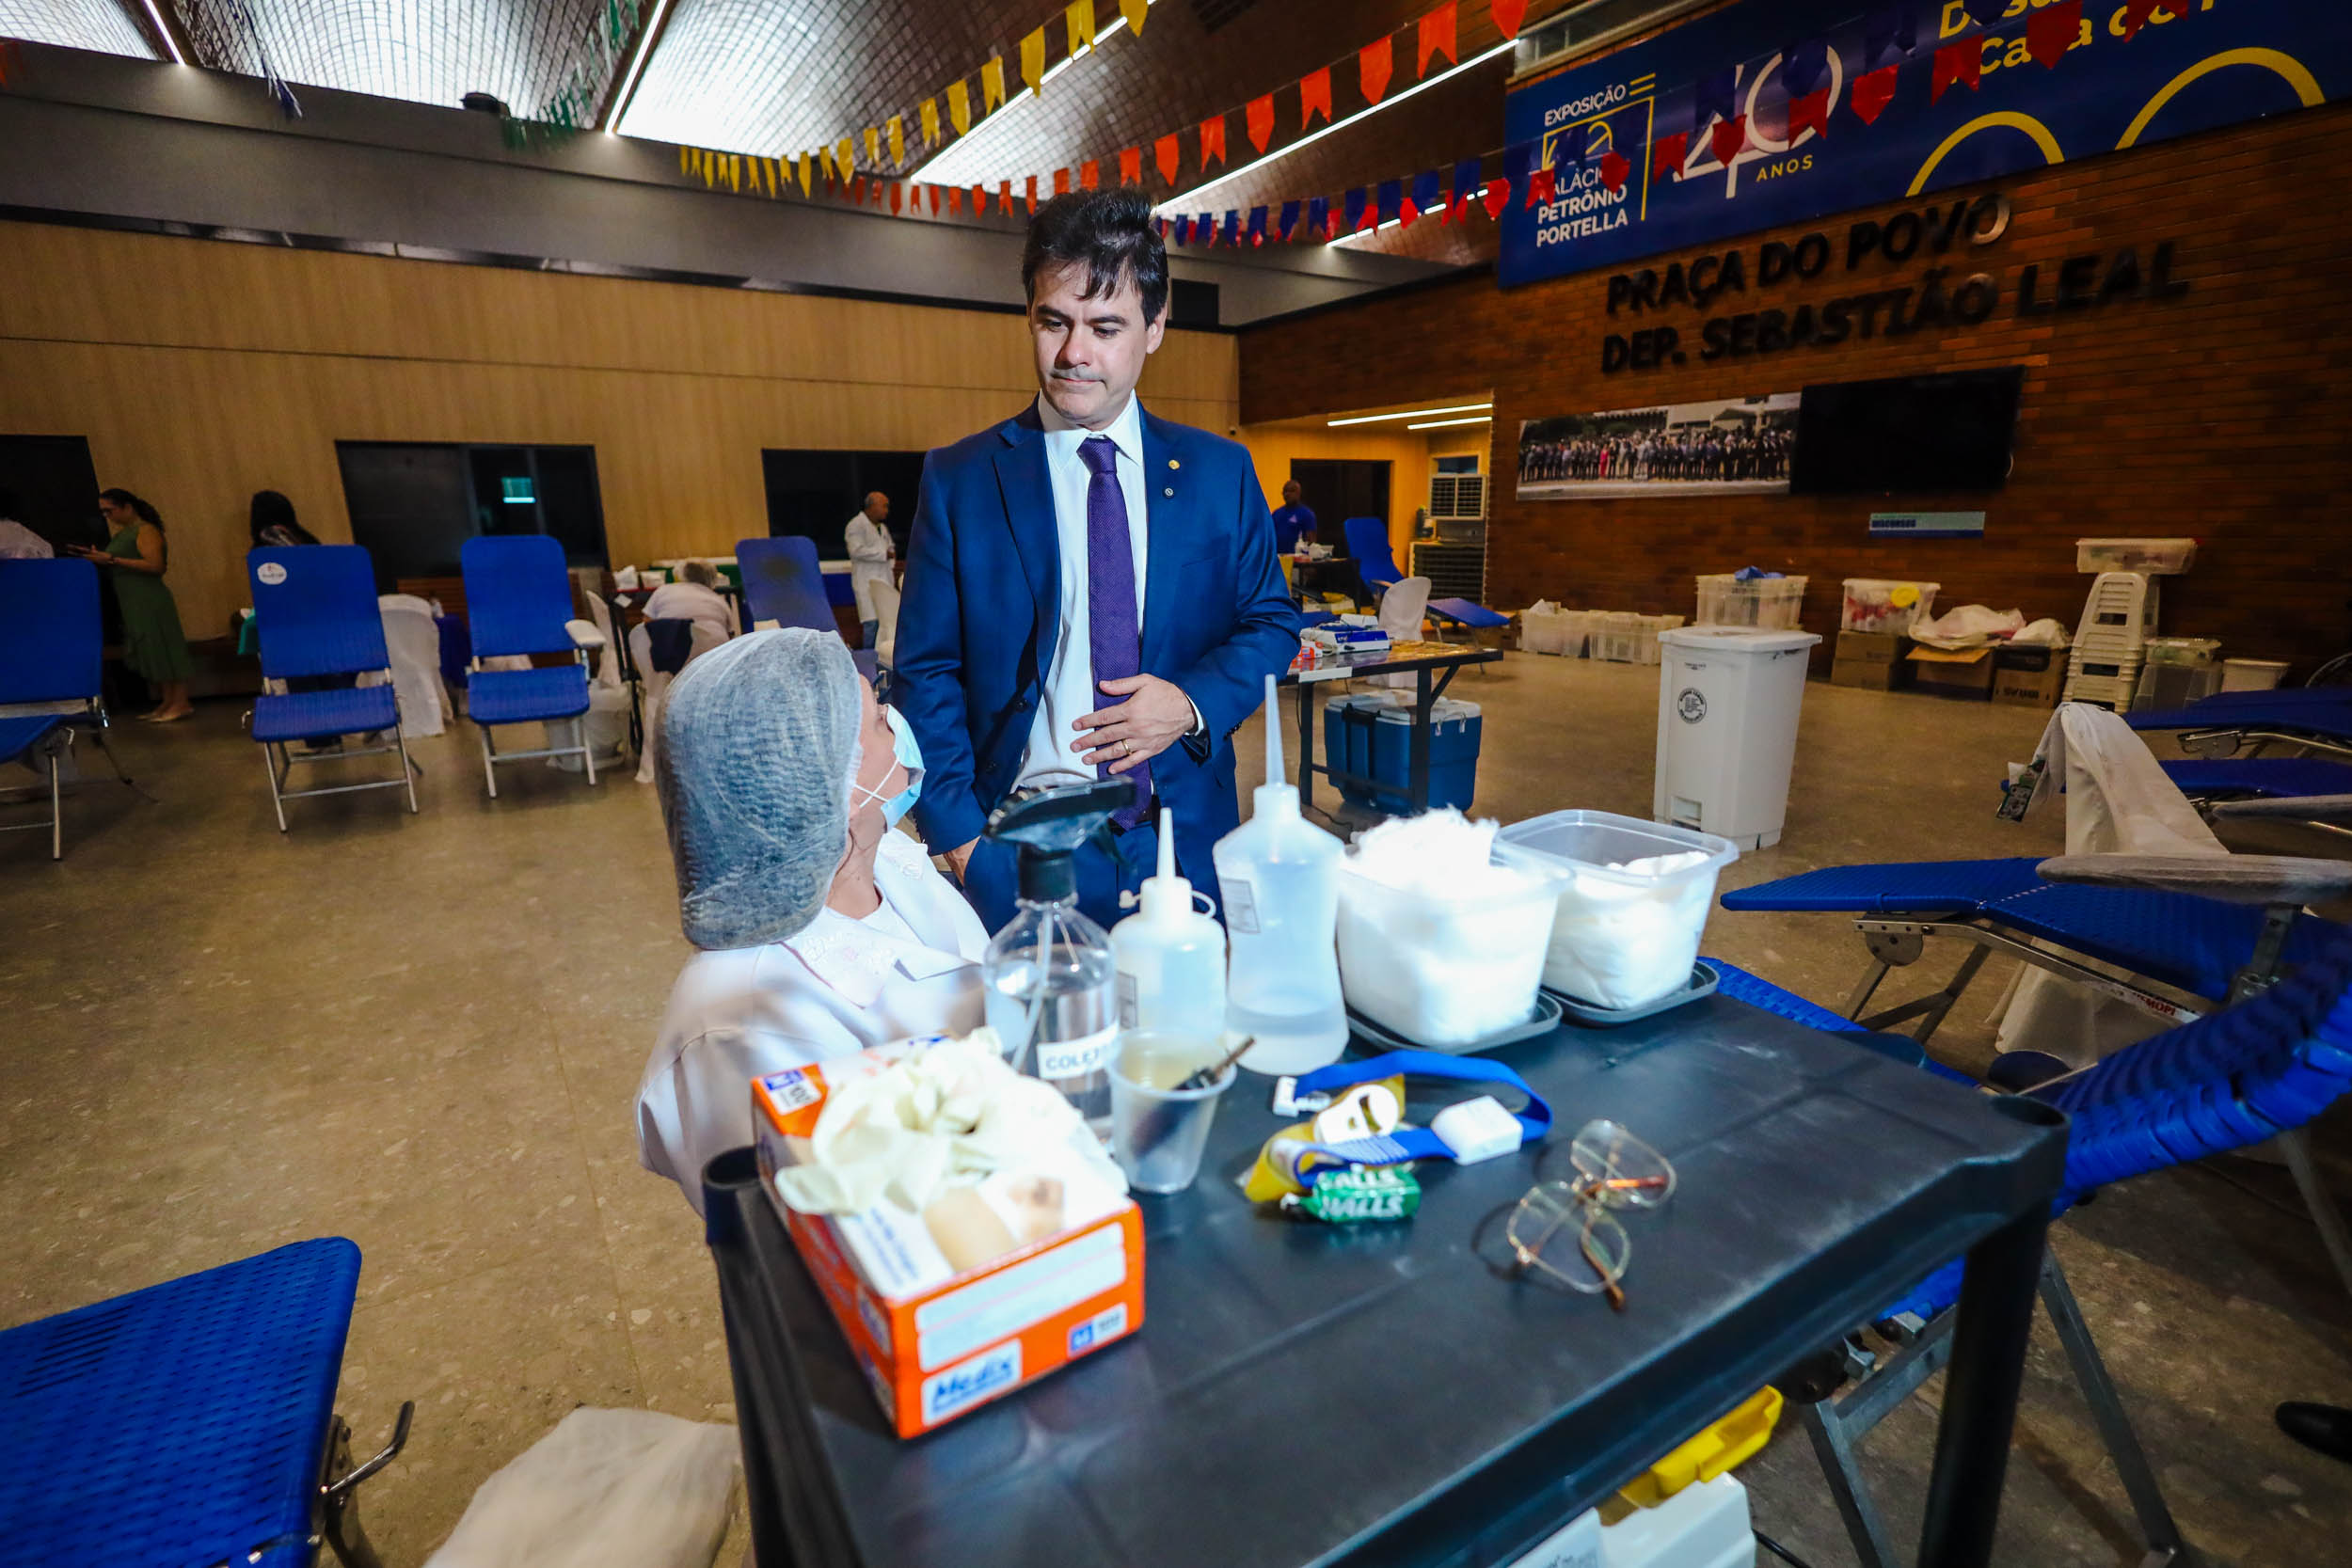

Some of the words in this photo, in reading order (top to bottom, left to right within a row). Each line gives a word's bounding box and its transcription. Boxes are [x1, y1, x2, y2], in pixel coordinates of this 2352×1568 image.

[1544, 84, 1627, 127] EXPOSIÇÃO
[1756, 154, 1814, 182] ANOS
[1537, 183, 1628, 225] PETRÔNIO
[1536, 208, 1629, 247] PORTELLA
[1605, 249, 1747, 315] PRAÇA
[1757, 232, 1830, 286] DO
[1846, 193, 2011, 271] POVO
[1601, 325, 1688, 375] DEP.
[1700, 265, 1999, 362] SEBASTIÃO
[2017, 240, 2192, 318] LEAL
